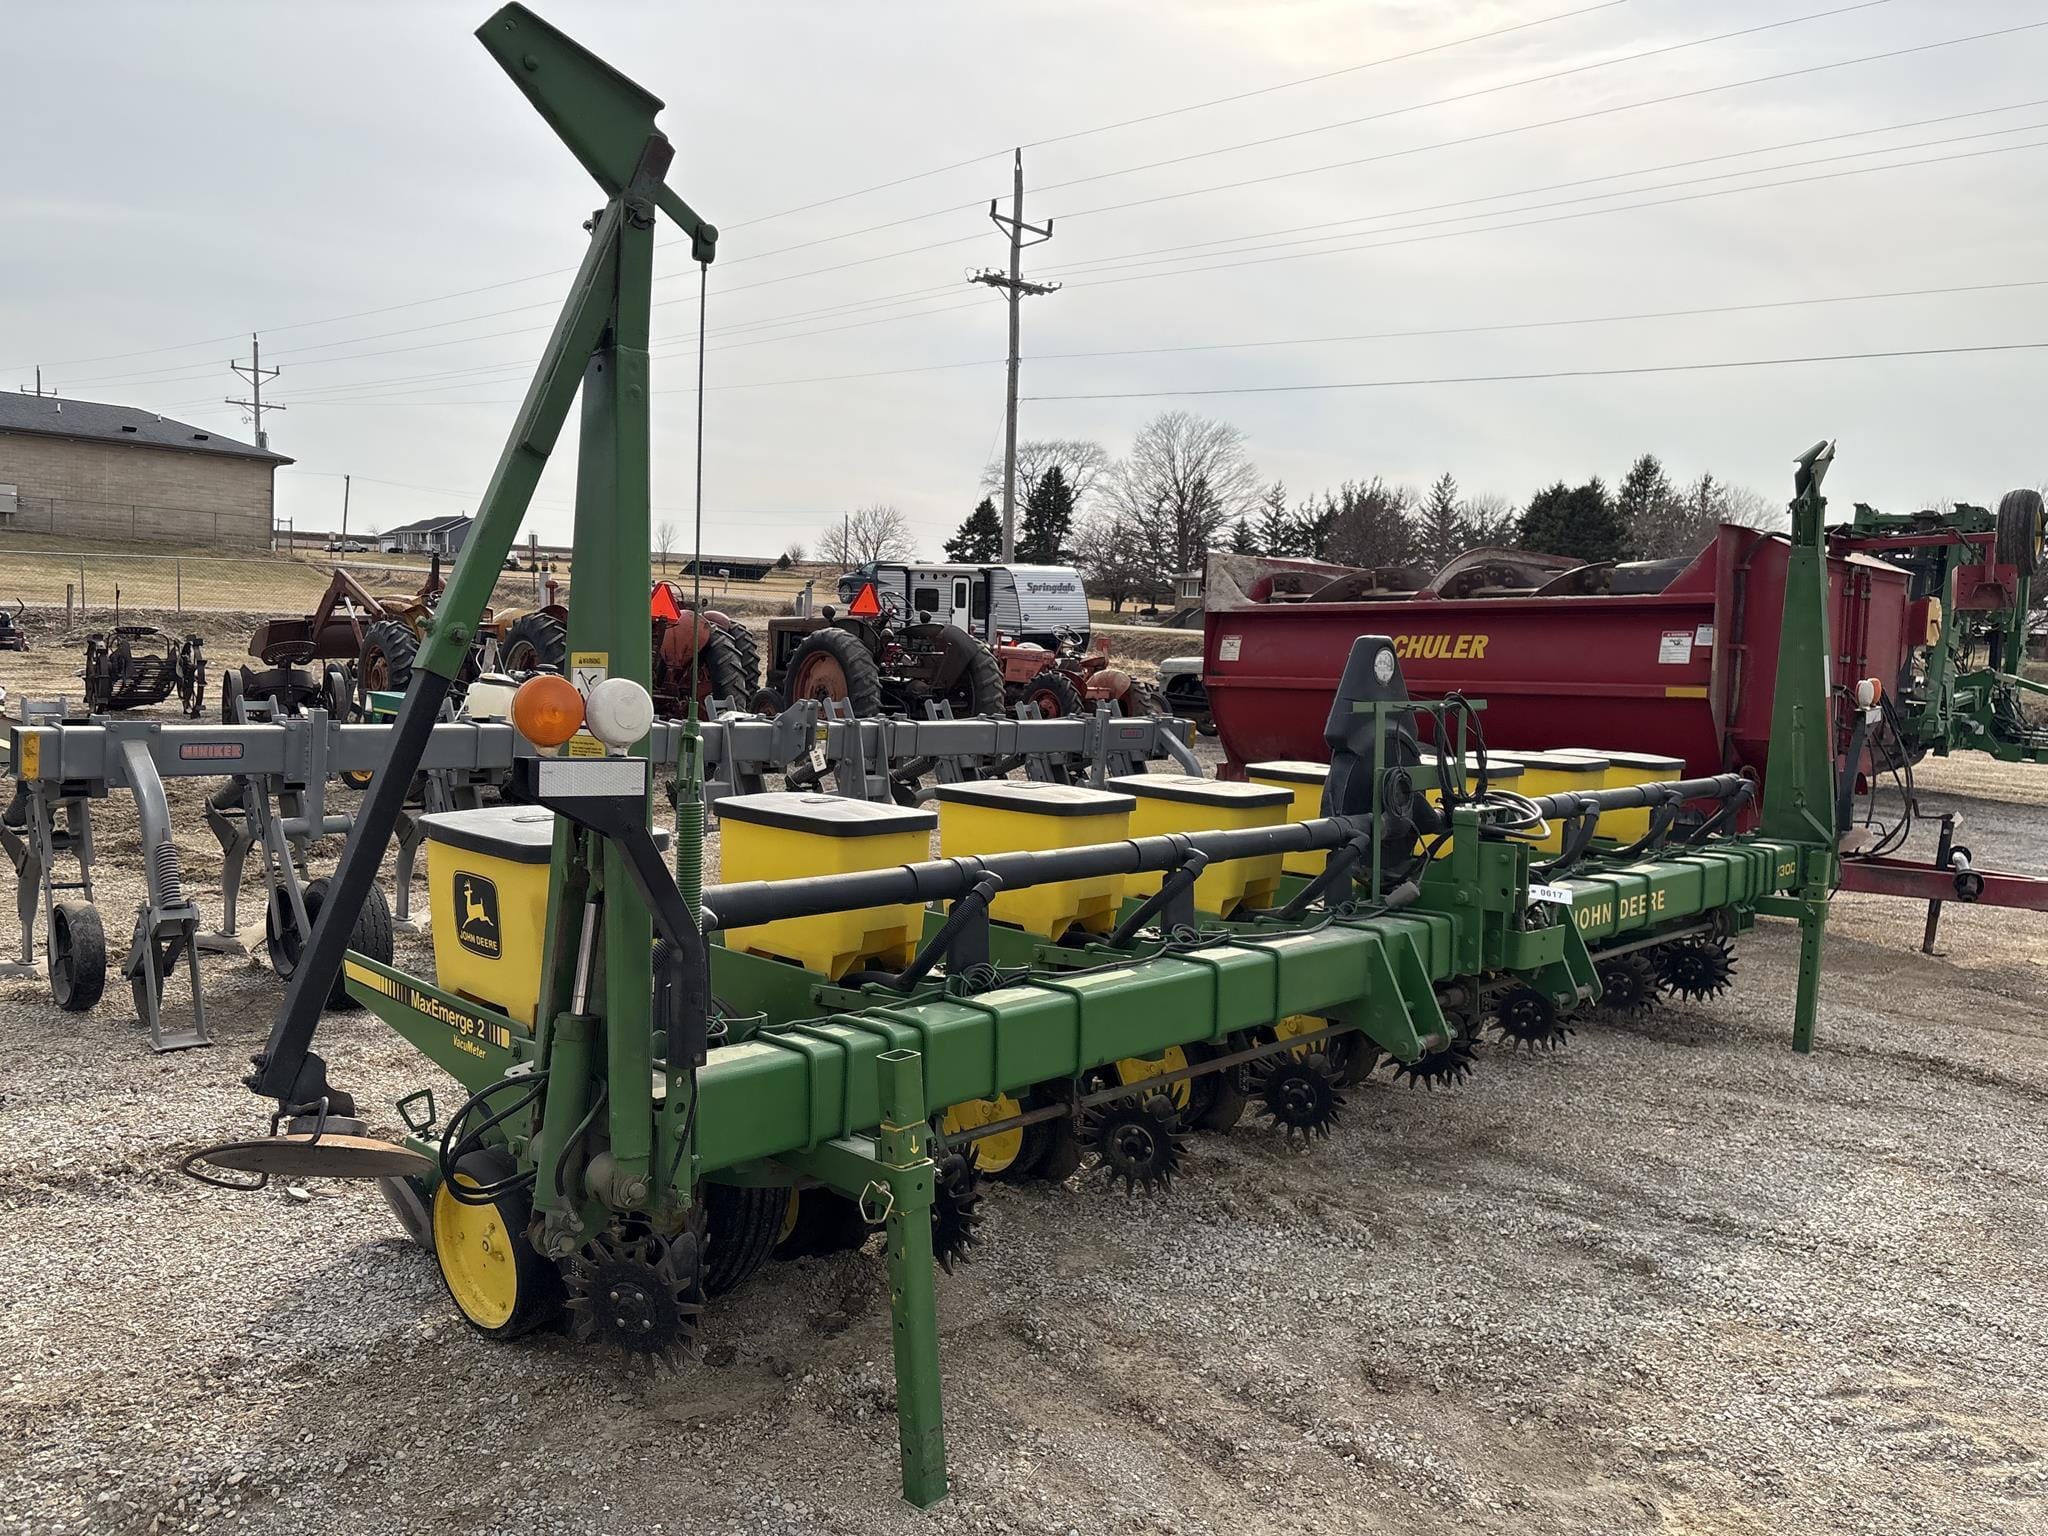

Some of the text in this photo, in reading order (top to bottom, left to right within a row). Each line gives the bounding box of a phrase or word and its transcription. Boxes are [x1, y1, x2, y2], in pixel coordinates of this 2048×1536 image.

[1026, 582, 1076, 594] Springdale
[1393, 635, 1489, 658] CHULER
[1540, 889, 1563, 899] 0617
[1619, 889, 1666, 920] DEERE
[460, 930, 498, 951] JOHN DEERE
[411, 989, 485, 1039] MaxEmerge 2
[453, 1034, 487, 1060] VacuMeter
